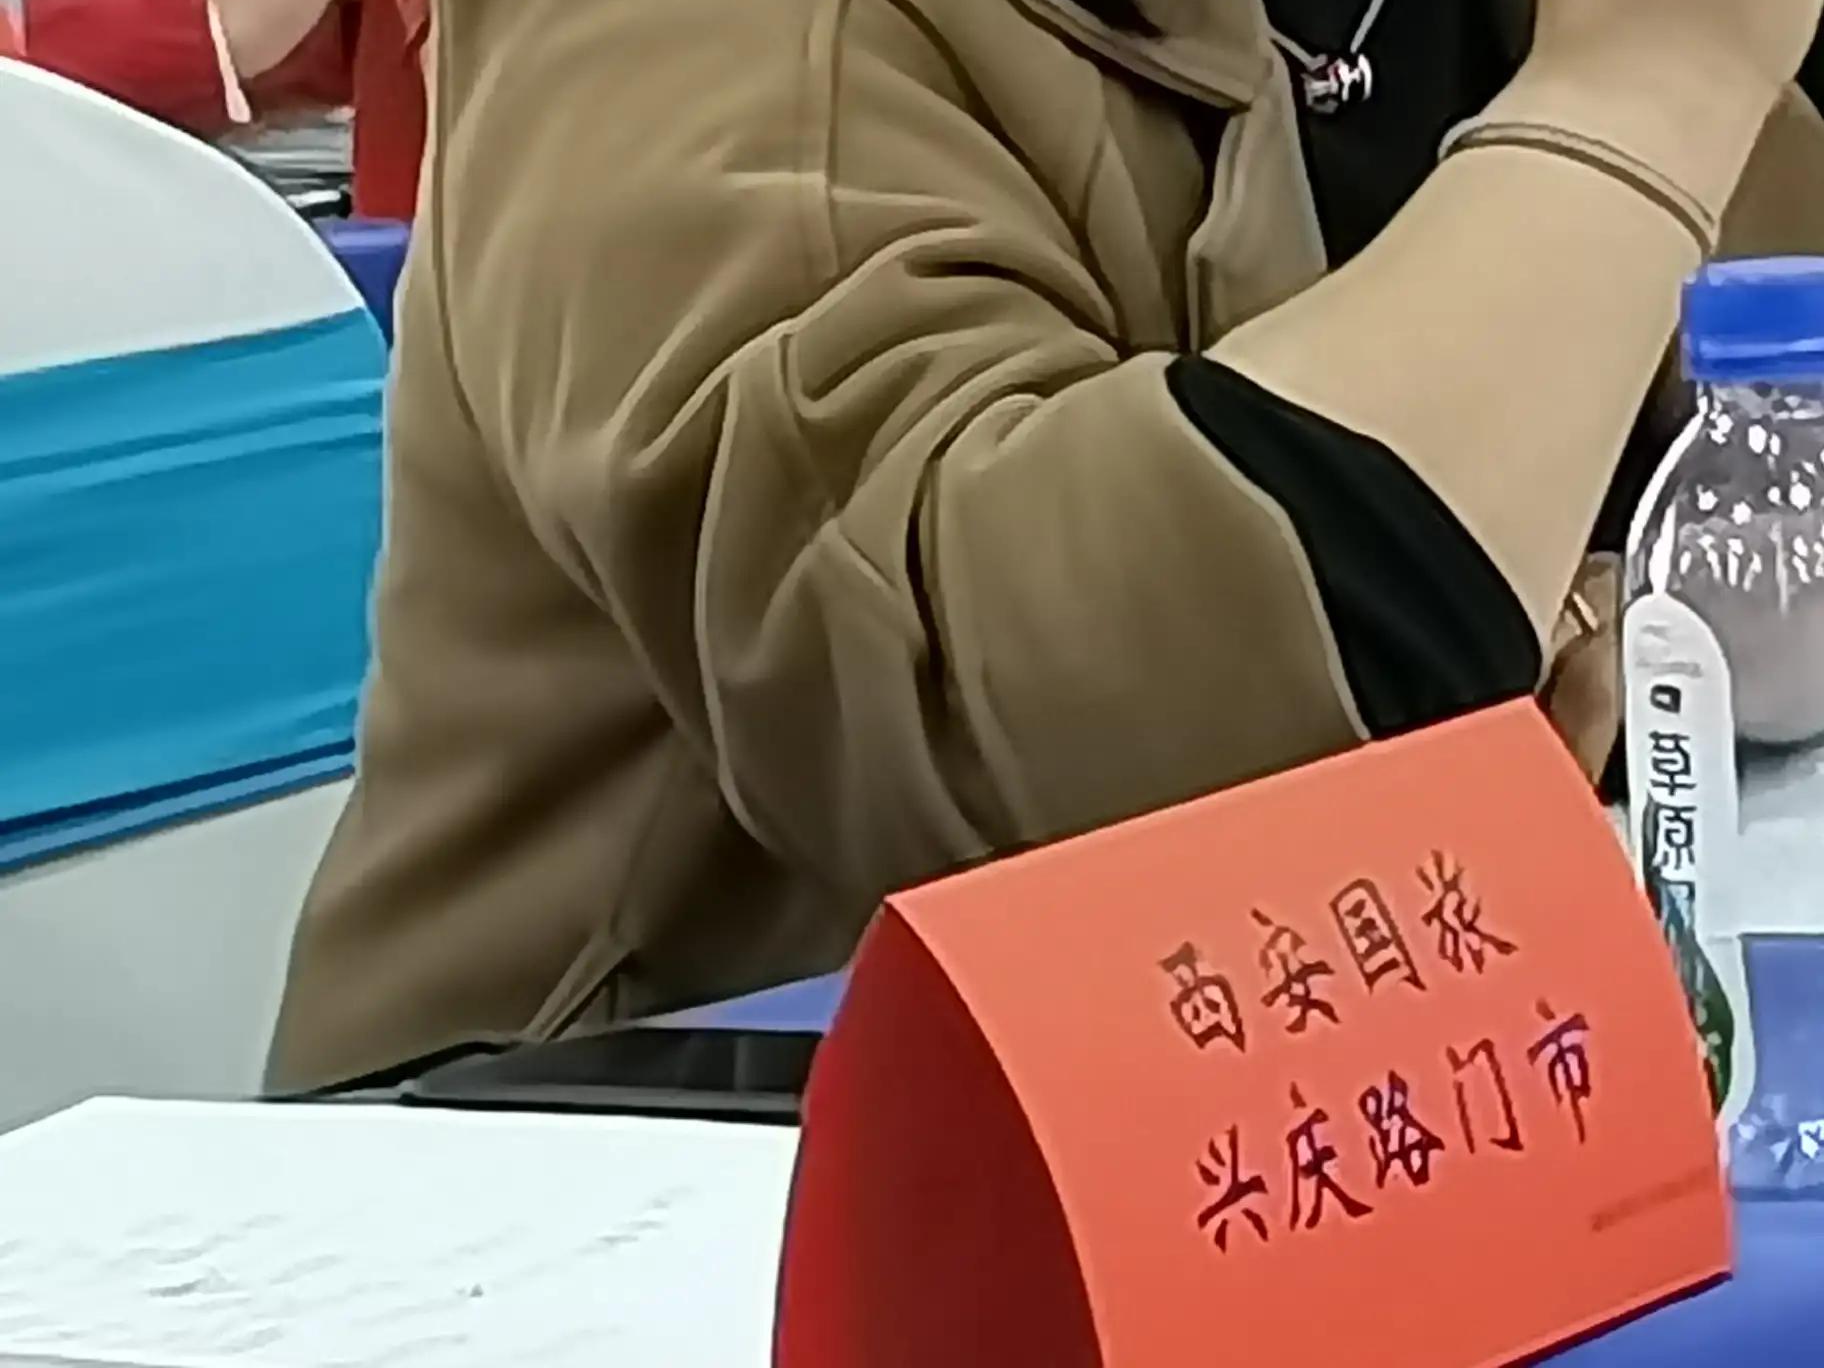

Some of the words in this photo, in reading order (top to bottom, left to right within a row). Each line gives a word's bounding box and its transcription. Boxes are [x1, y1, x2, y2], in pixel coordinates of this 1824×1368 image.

[1158, 848, 1519, 1052] 西安国旅
[1196, 999, 1592, 1253] 兴庆路门市
